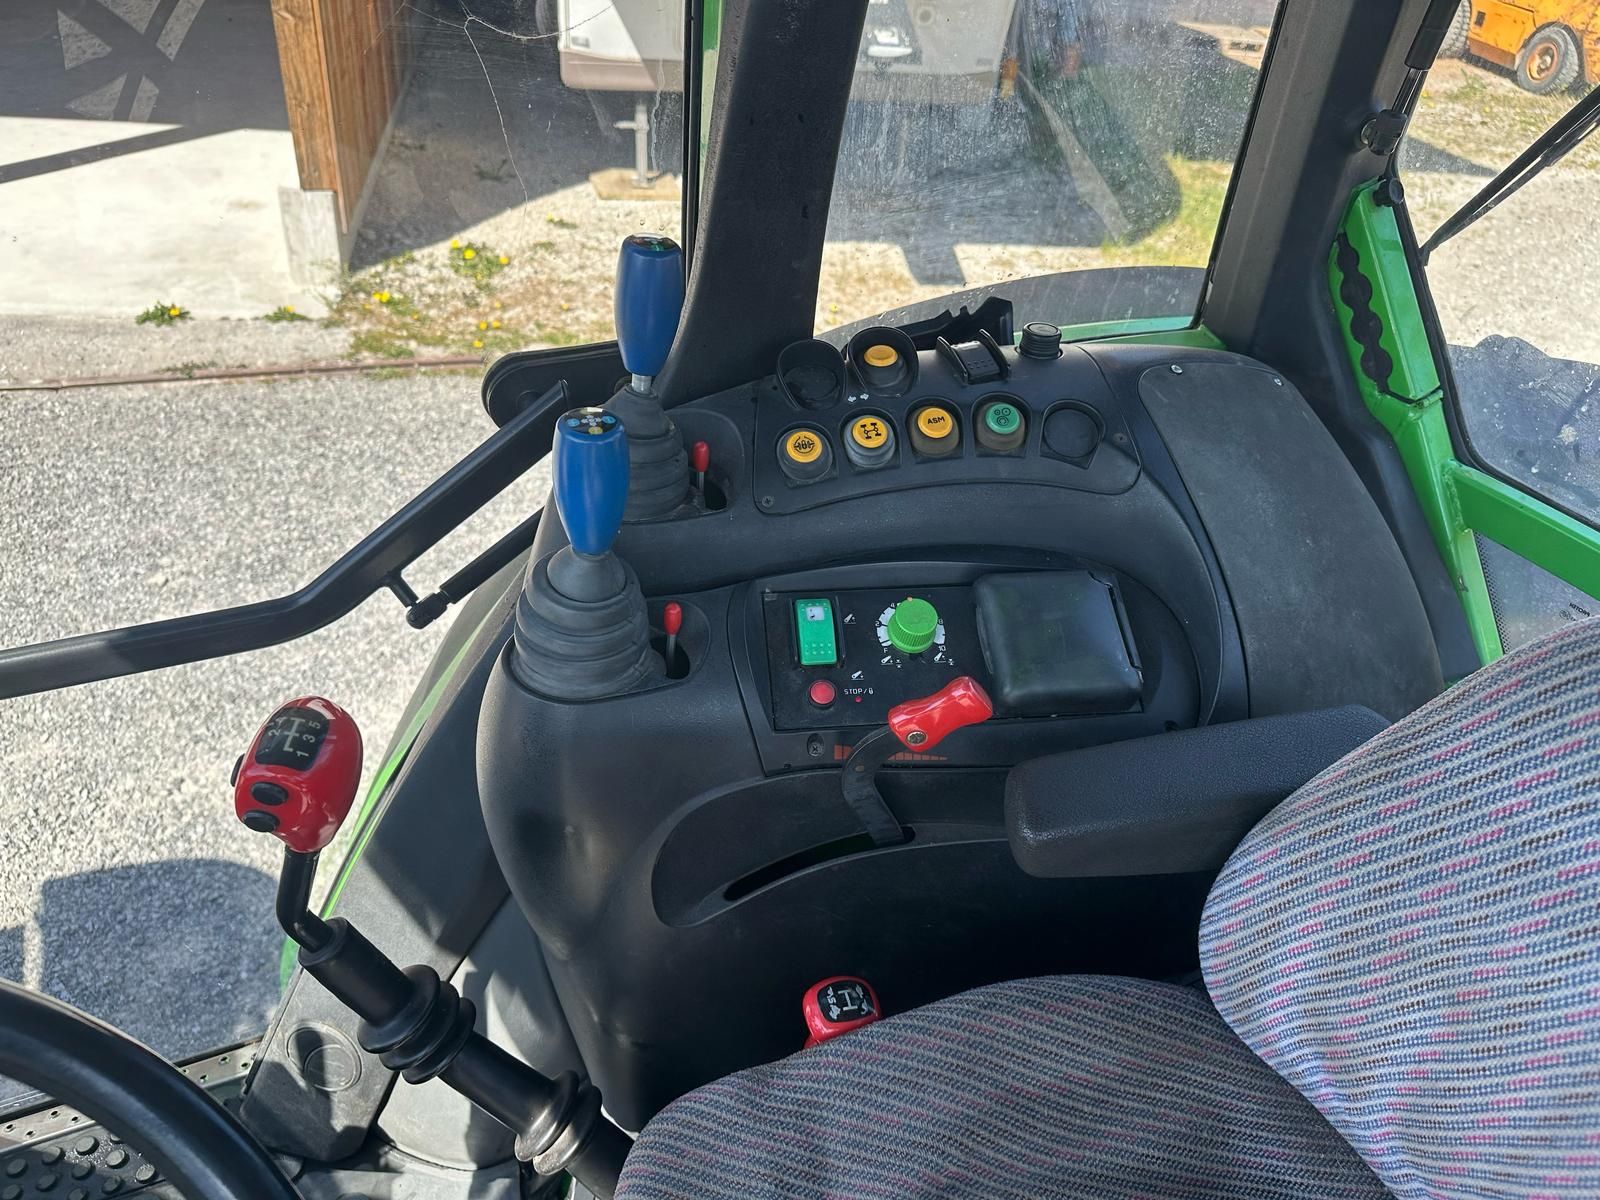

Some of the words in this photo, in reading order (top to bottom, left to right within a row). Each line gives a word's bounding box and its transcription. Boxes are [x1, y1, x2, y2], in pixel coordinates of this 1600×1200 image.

[927, 416, 946, 425] ASM
[308, 720, 320, 729] 5
[268, 729, 281, 737] 2
[302, 734, 316, 744] 3
